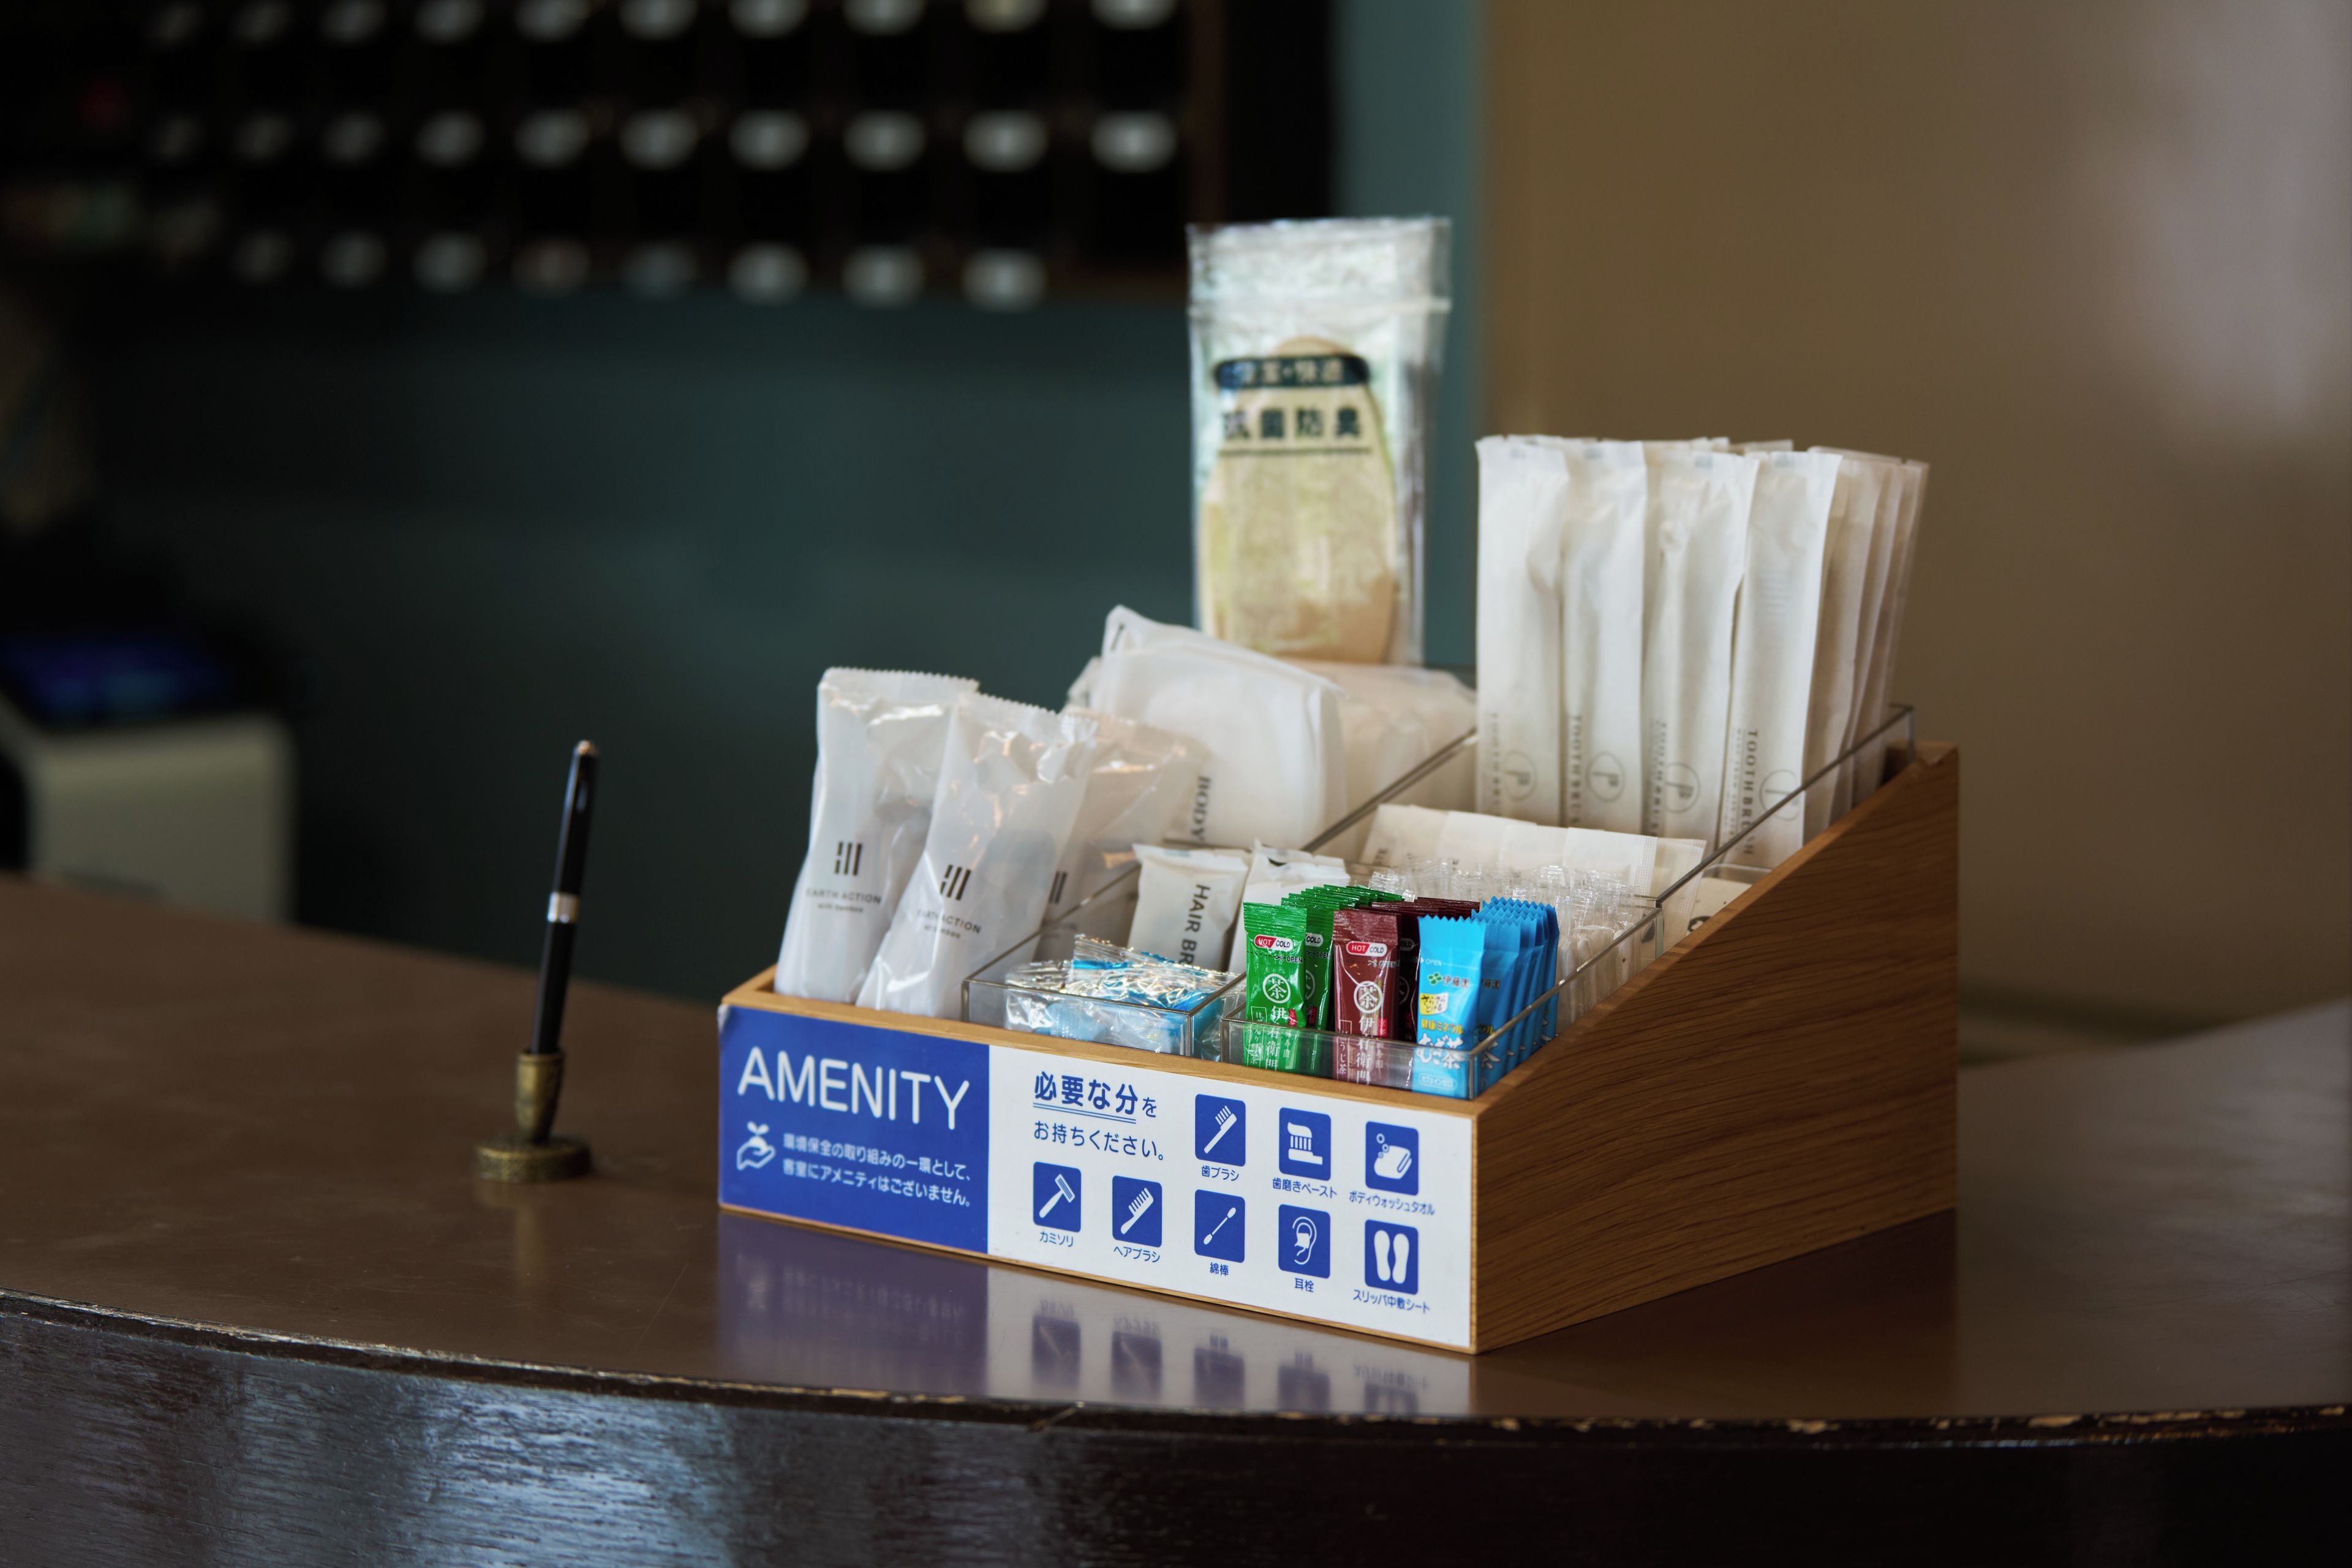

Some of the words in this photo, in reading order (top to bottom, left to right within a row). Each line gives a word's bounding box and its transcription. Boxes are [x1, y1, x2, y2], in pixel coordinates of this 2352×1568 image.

[841, 891, 882, 905] ACTION
[1185, 883, 1211, 932] HAIR
[1257, 938, 1272, 946] HOT
[1306, 935, 1321, 944] COLD
[1268, 978, 1287, 1000] 茶
[1358, 986, 1378, 1009] 茶
[737, 1047, 970, 1131] AMENITY
[1034, 1071, 1157, 1118] 必要な分を
[1034, 1120, 1164, 1161] お持ちください。
[1200, 1164, 1240, 1182] 歯ブラシ
[1272, 1177, 1338, 1199] 歯磨きペースト
[1349, 1190, 1435, 1216] ボディウォッシュタオル
[1039, 1231, 1074, 1248] カミソリ
[1113, 1245, 1161, 1263] ヘアブラシ
[1209, 1262, 1229, 1276] 綿棒
[1294, 1277, 1314, 1293] 耳栓
[1353, 1289, 1431, 1314] スリッパ中敷シート
